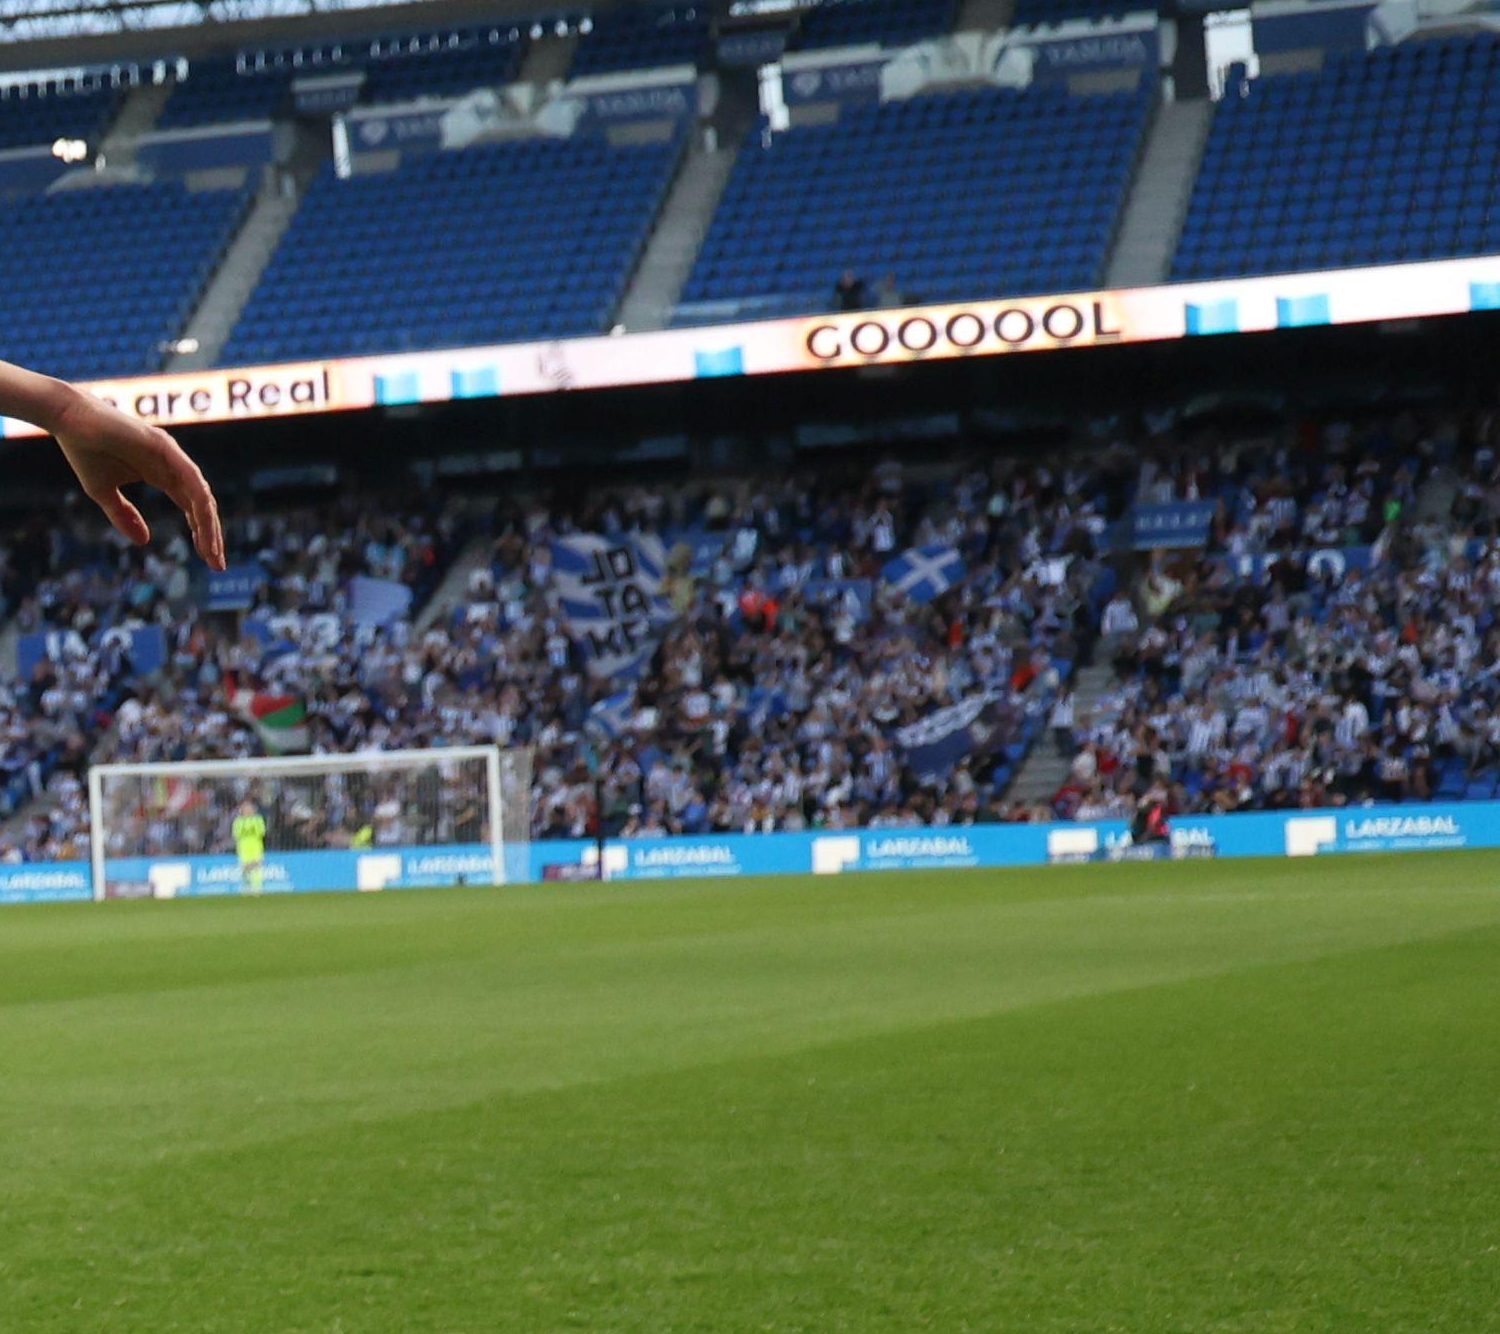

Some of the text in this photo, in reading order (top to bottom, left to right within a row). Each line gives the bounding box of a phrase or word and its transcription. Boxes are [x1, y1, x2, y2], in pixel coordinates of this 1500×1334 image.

[806, 301, 1121, 361] GOOOOOL
[134, 370, 330, 417] are Real
